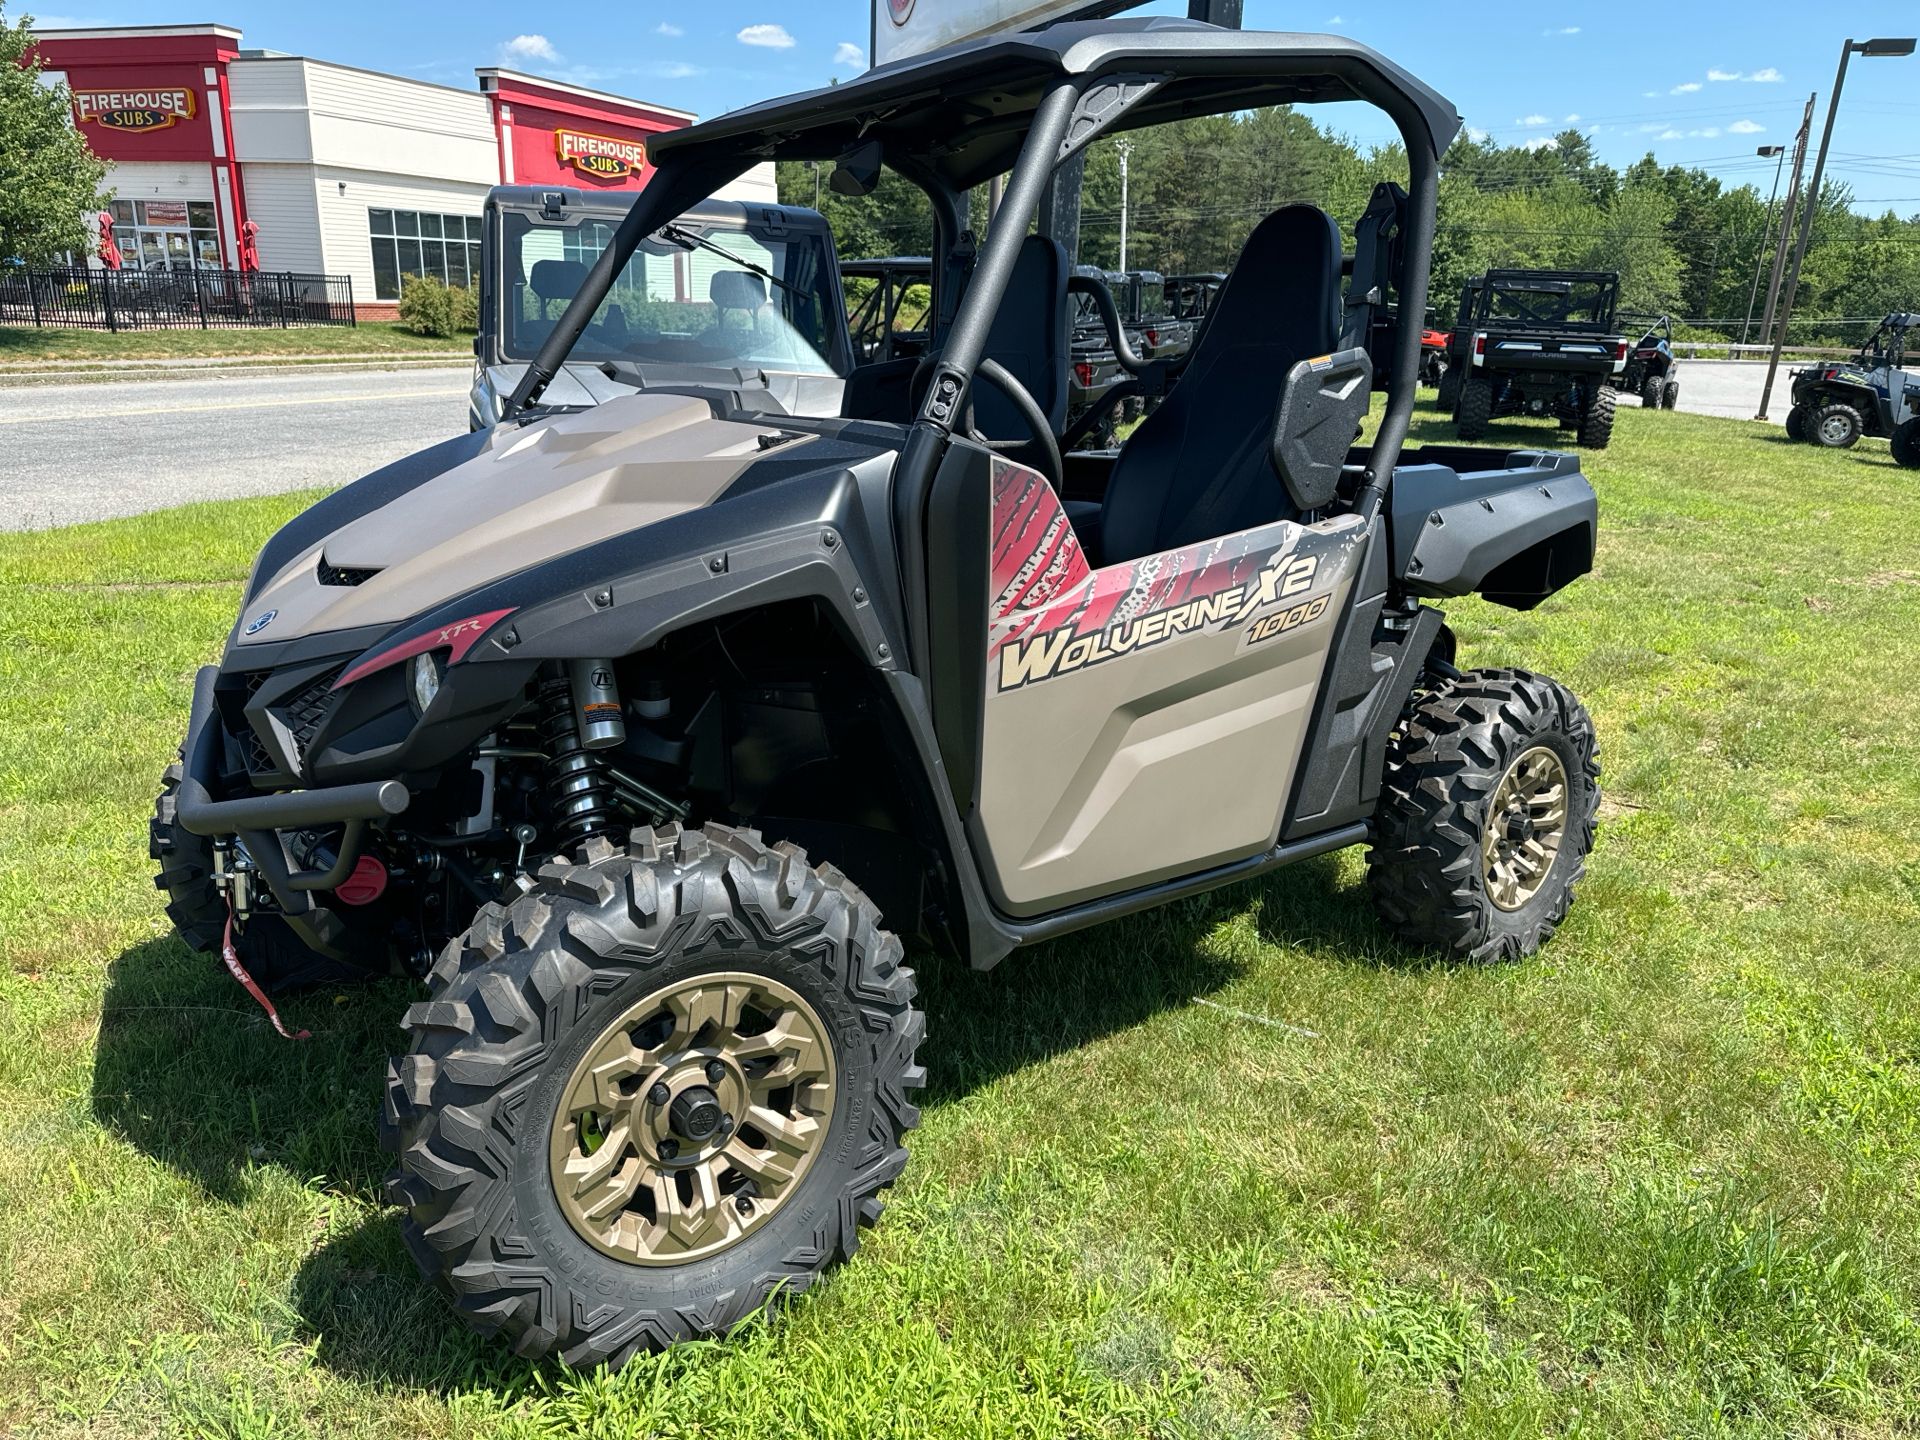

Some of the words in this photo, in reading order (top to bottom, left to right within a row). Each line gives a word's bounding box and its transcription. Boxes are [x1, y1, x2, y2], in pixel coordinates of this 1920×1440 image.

[77, 92, 187, 120] FIREHOUSE
[113, 111, 154, 126] SUBS
[562, 134, 643, 170] FIREHOUSE
[589, 155, 620, 173] SUBS
[437, 620, 482, 643] XT-R
[1246, 592, 1332, 646] 1000
[999, 583, 1249, 692] WOLVERINE
[593, 672, 614, 687] ZF
[762, 949, 862, 1050] MAXXIS
[529, 1213, 653, 1301] BIGHORN
